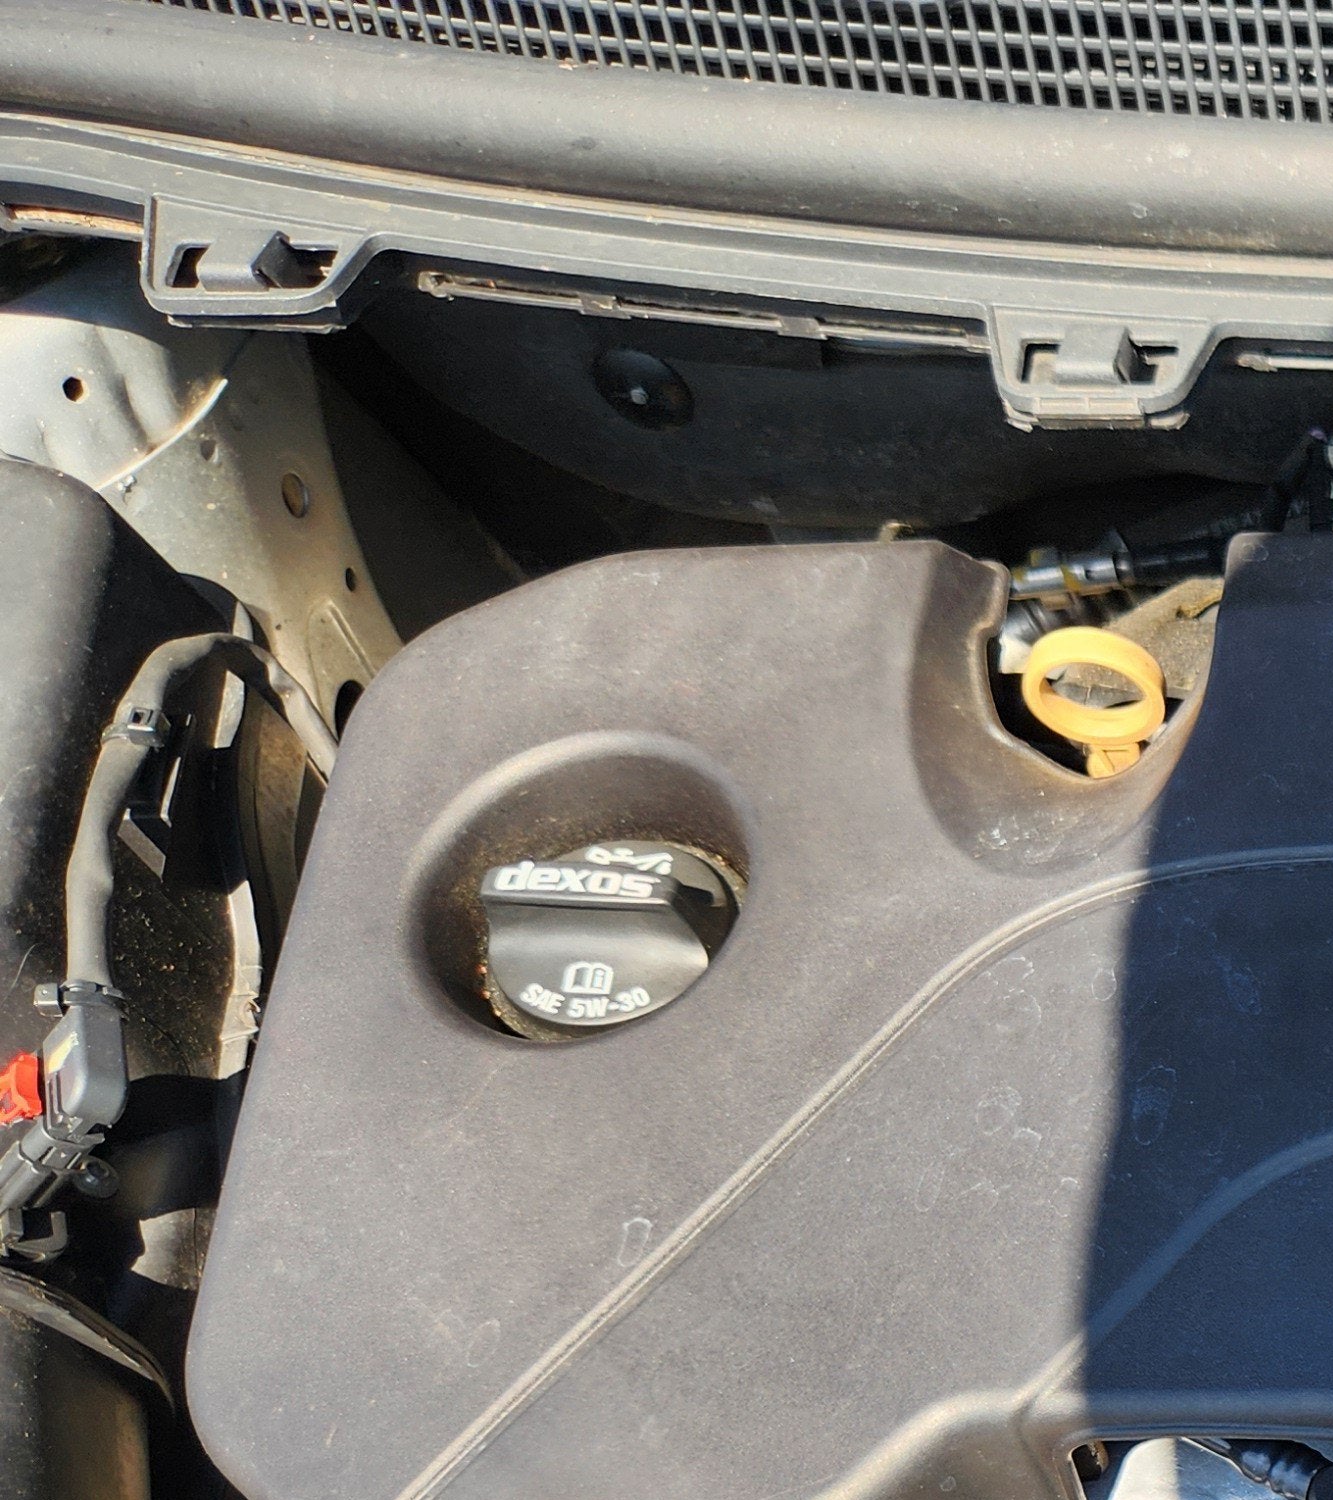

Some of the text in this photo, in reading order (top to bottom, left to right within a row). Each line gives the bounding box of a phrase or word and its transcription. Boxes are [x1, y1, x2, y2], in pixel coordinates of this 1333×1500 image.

[494, 861, 660, 898] dexos
[519, 982, 651, 1019] SAE 5W-30
